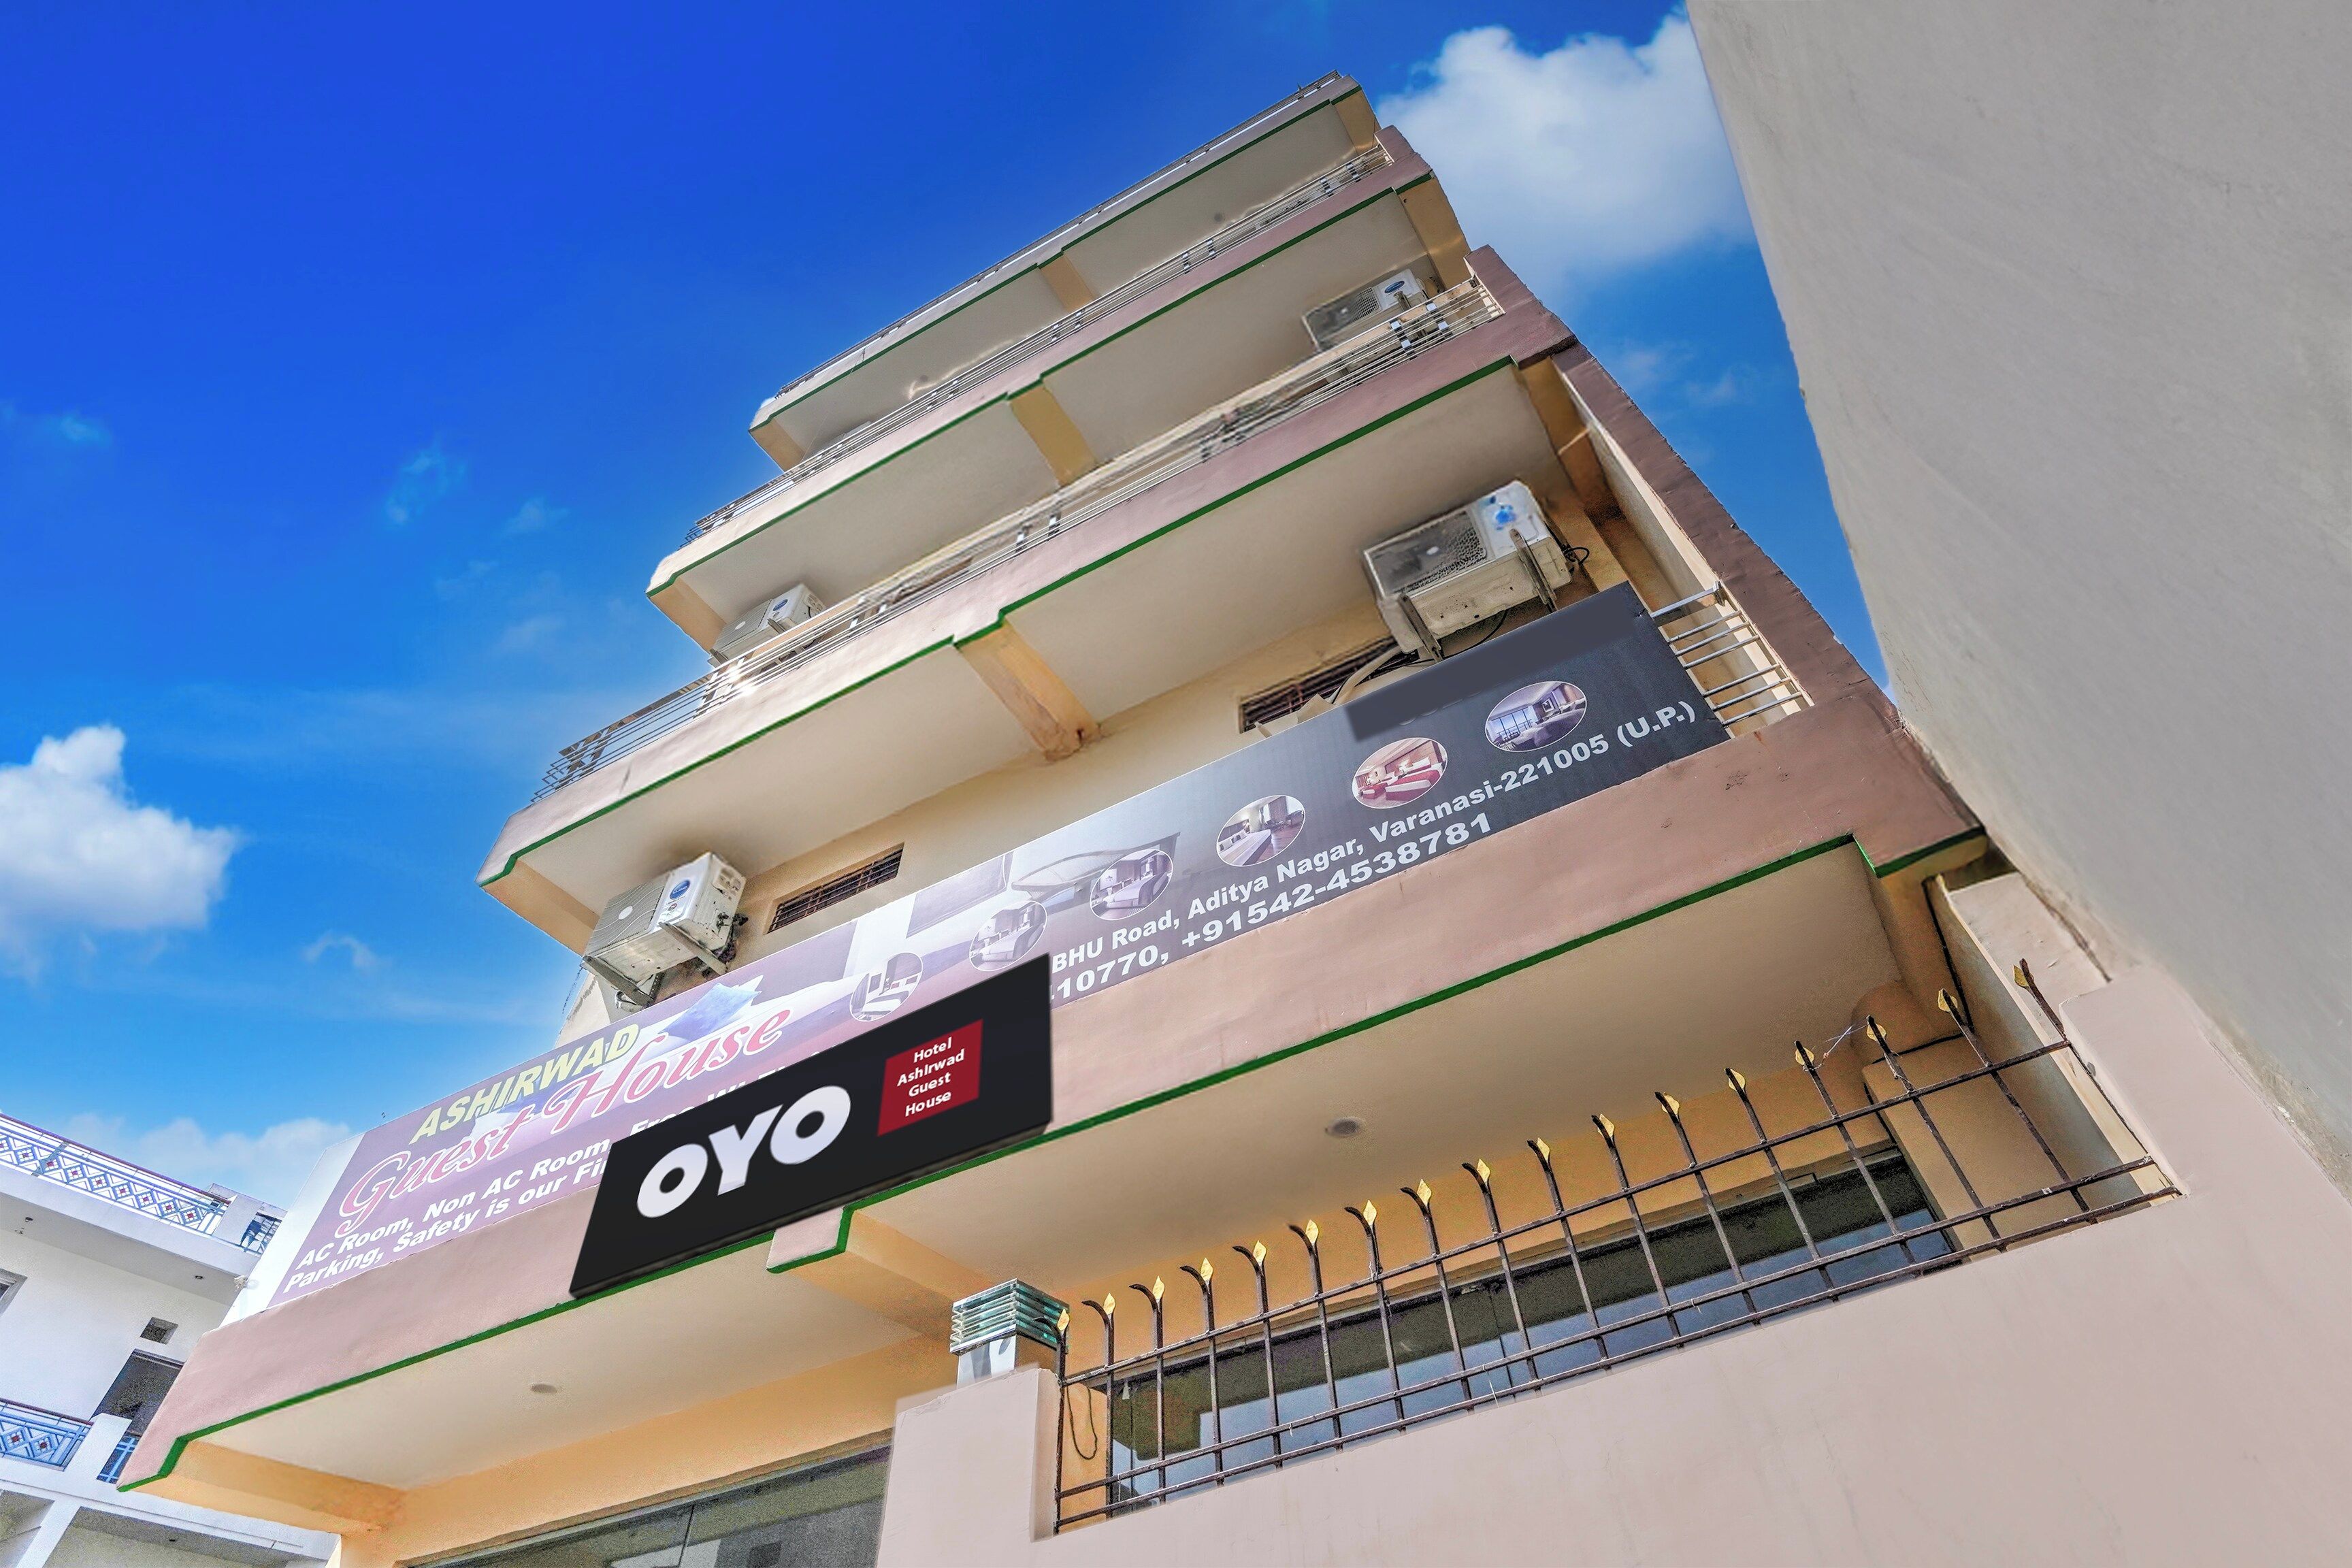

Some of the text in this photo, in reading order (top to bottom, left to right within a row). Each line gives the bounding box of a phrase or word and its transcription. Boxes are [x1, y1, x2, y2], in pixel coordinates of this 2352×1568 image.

[1051, 700, 1696, 974] BHU Road, Aditya Nagar, Varanasi-221005 (U.P.)
[1050, 812, 1492, 1003] 10770, +91542-4538781
[409, 1024, 641, 1145] ASHIRWAD
[904, 1091, 951, 1117] House
[909, 1072, 951, 1097] Guest
[913, 1036, 952, 1063] Hotel
[333, 1104, 541, 1239] Guest
[542, 1009, 792, 1135] House
[637, 1085, 851, 1218] OYO
[285, 1250, 385, 1294] Parking,
[392, 1208, 479, 1254] Safety
[485, 1196, 510, 1219] is
[518, 1175, 568, 1205] our
[295, 1241, 334, 1271] AC
[338, 1216, 414, 1255] Room,
[422, 1190, 477, 1222] Non
[484, 1170, 521, 1199] AC
